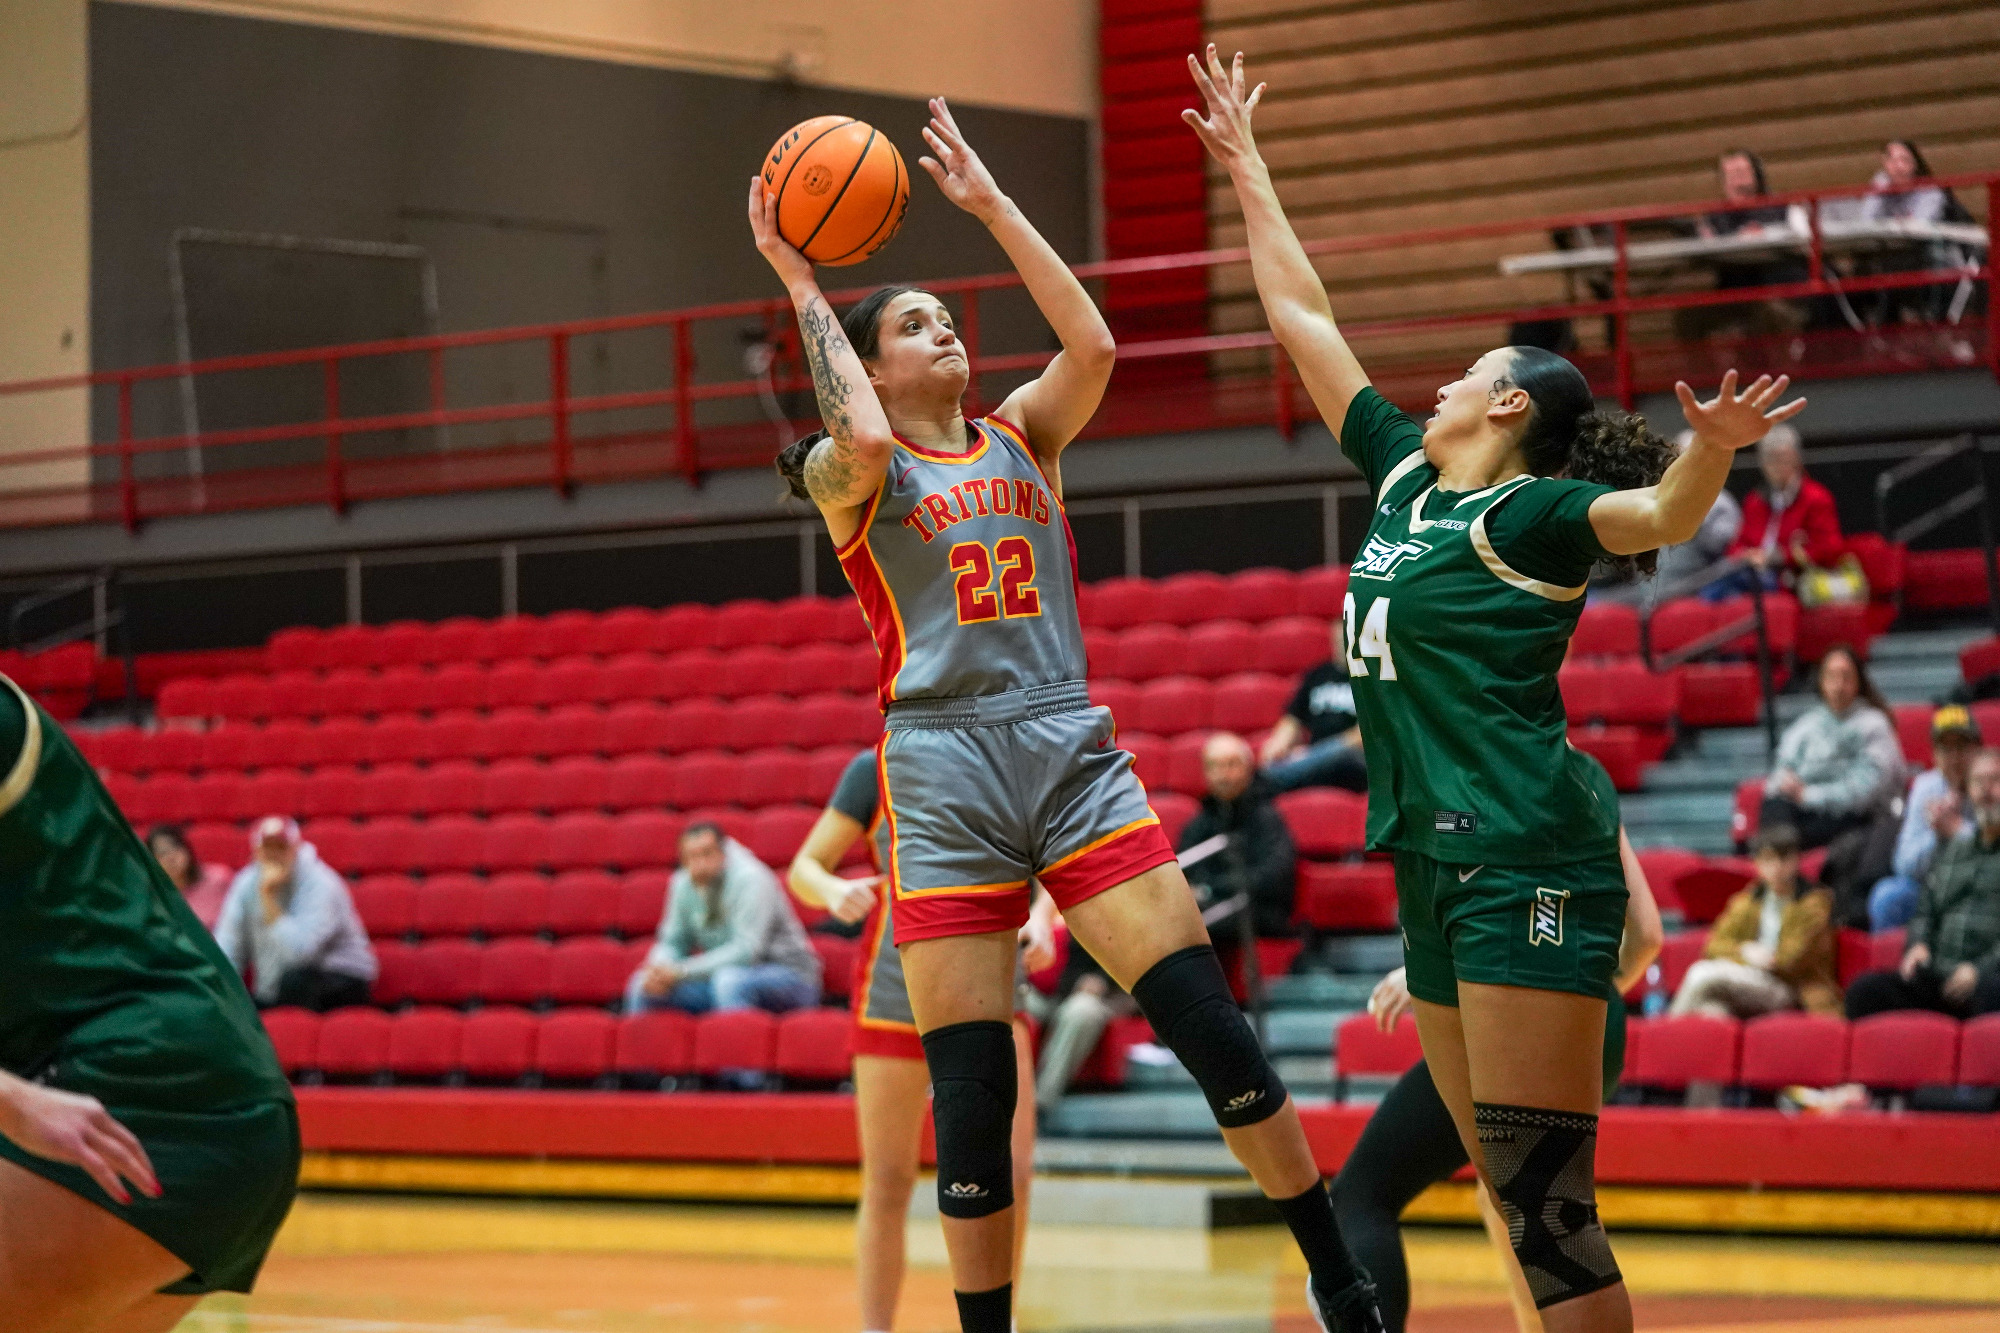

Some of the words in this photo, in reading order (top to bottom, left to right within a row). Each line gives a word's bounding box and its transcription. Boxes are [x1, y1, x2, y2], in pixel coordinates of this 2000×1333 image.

[765, 131, 799, 186] EVO
[902, 477, 1050, 544] TRITONS
[949, 536, 1042, 625] 22
[1343, 592, 1398, 681] 24
[1460, 818, 1470, 828] XL
